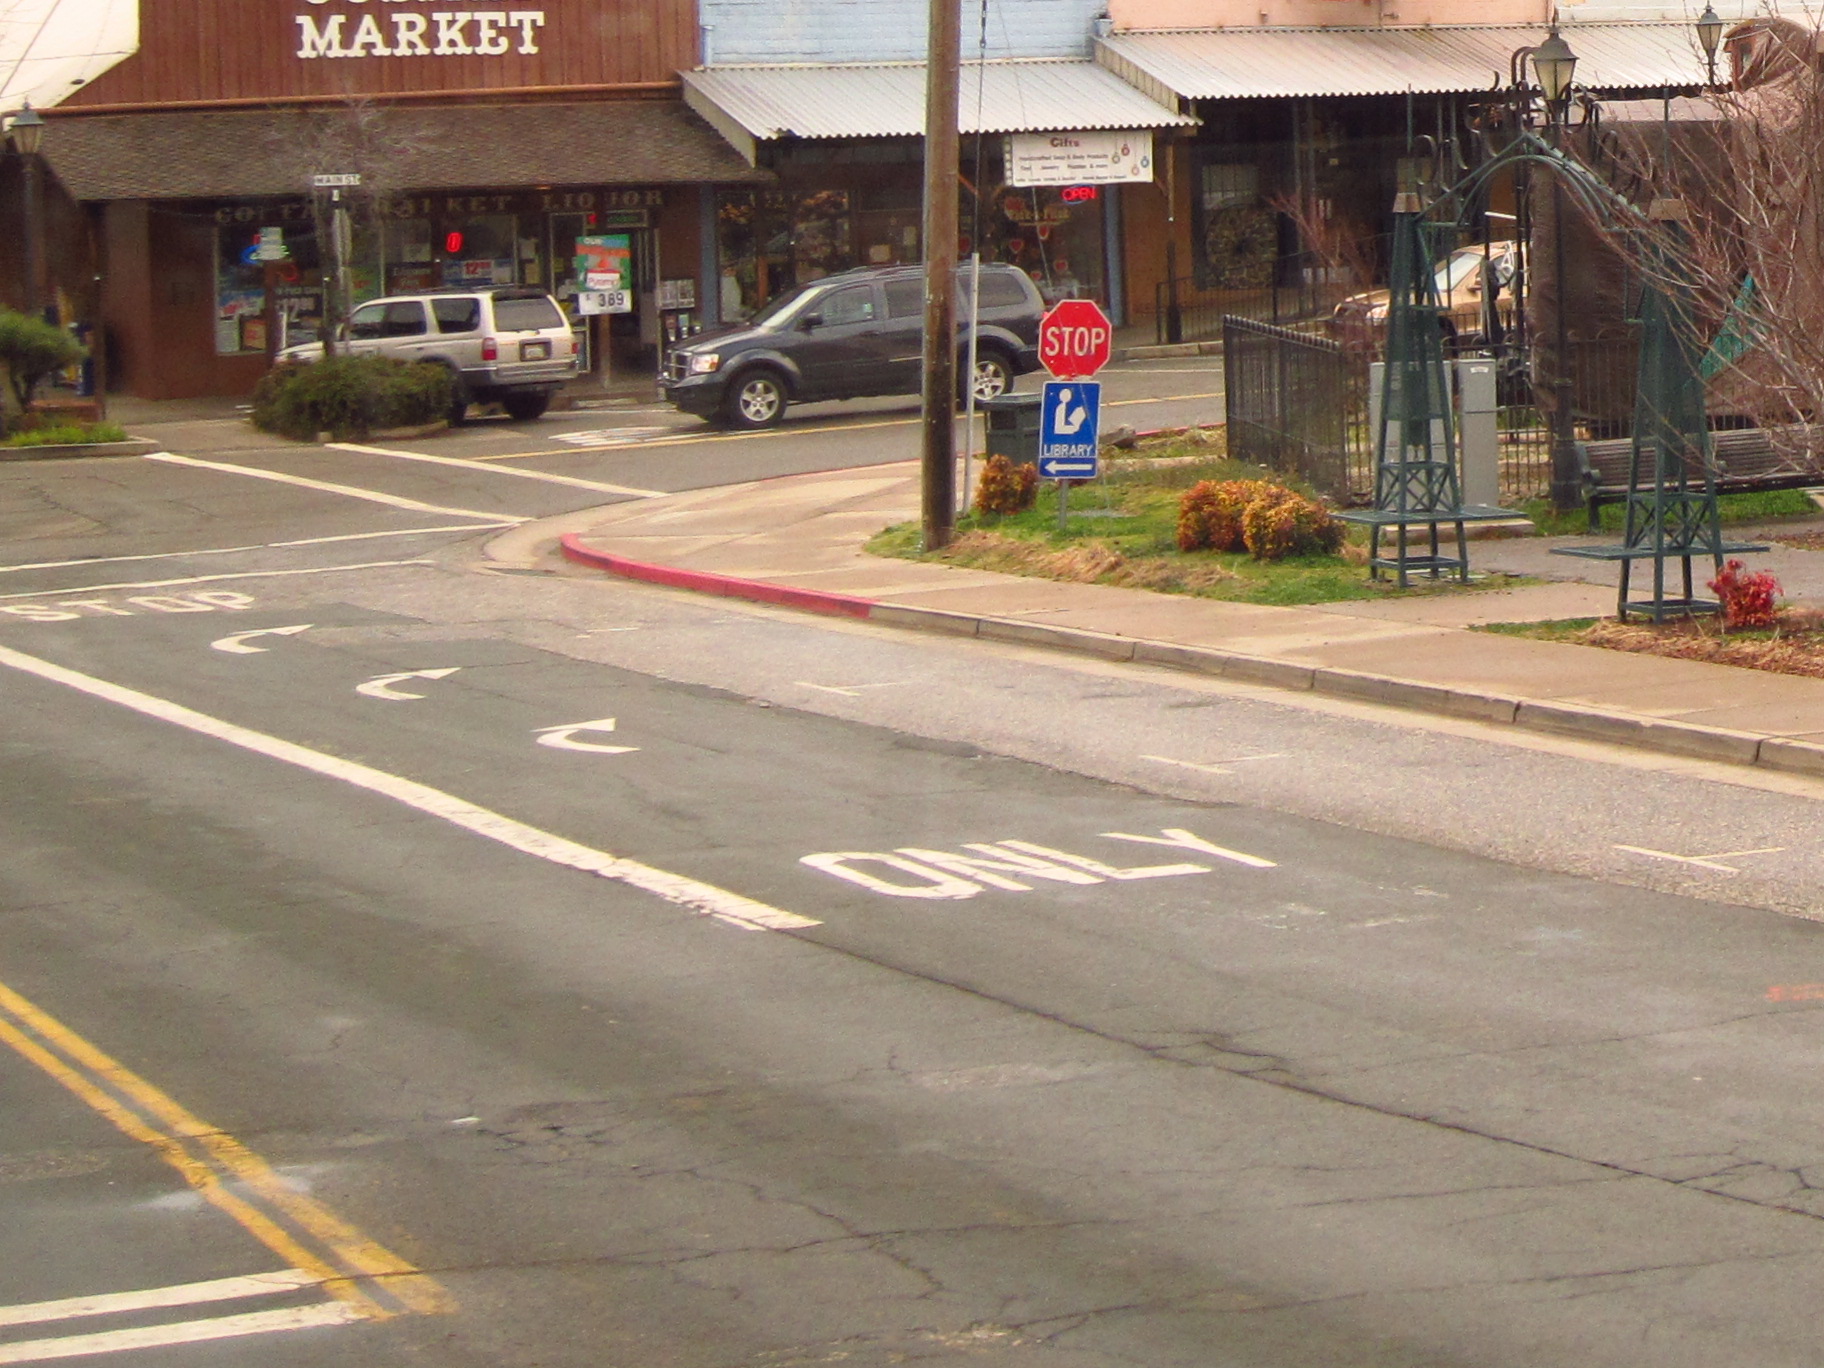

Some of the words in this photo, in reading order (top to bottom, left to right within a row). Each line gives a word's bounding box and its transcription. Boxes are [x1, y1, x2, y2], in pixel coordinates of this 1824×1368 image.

[295, 11, 545, 59] MARKET
[1050, 136, 1080, 149] Gifts
[316, 176, 343, 184] MAIN
[1061, 186, 1098, 201] OPEN
[598, 292, 625, 307] 389
[1044, 326, 1106, 357] STOP
[1043, 444, 1093, 457] LIBRARY
[0, 590, 255, 622] STOP
[799, 828, 1277, 900] ONLY
